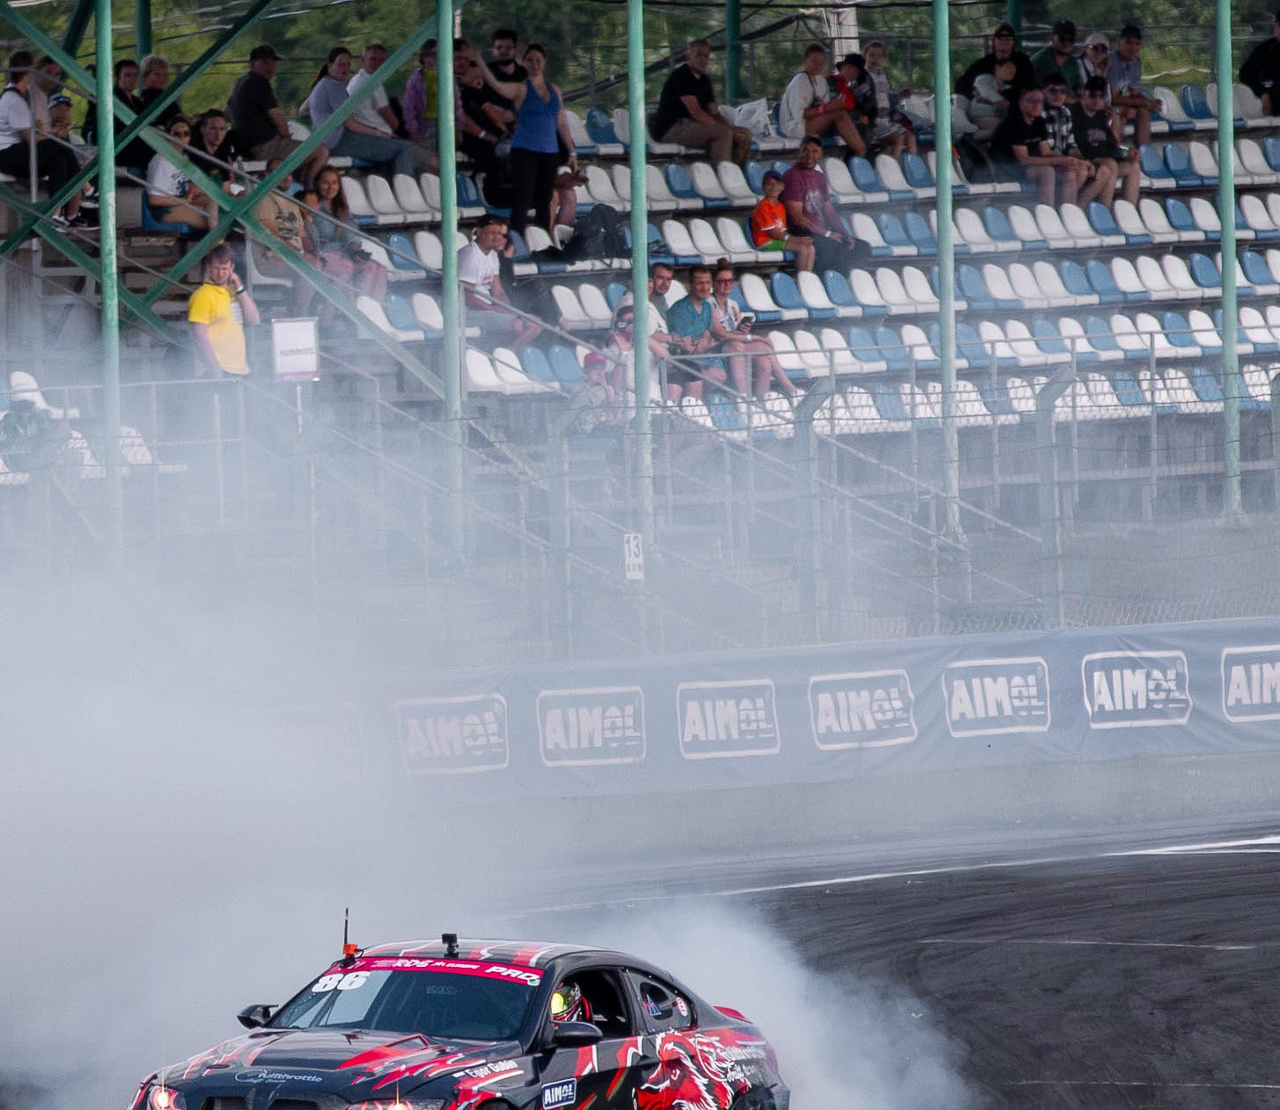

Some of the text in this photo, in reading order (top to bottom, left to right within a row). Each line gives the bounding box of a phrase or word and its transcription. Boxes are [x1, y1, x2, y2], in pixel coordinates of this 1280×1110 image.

[625, 534, 640, 558] 13
[818, 687, 909, 734] AIMOL
[952, 674, 1045, 721] AIMOL
[1093, 667, 1188, 713] AIMOL
[407, 711, 504, 757] AIMOL
[544, 704, 641, 750] AIMOL
[683, 697, 774, 742] AIMOL
[311, 970, 370, 993] 86
[392, 959, 433, 968] RDS
[485, 965, 539, 983] PRO
[464, 1066, 491, 1079] Egor
[544, 1083, 574, 1105] AIMOL
